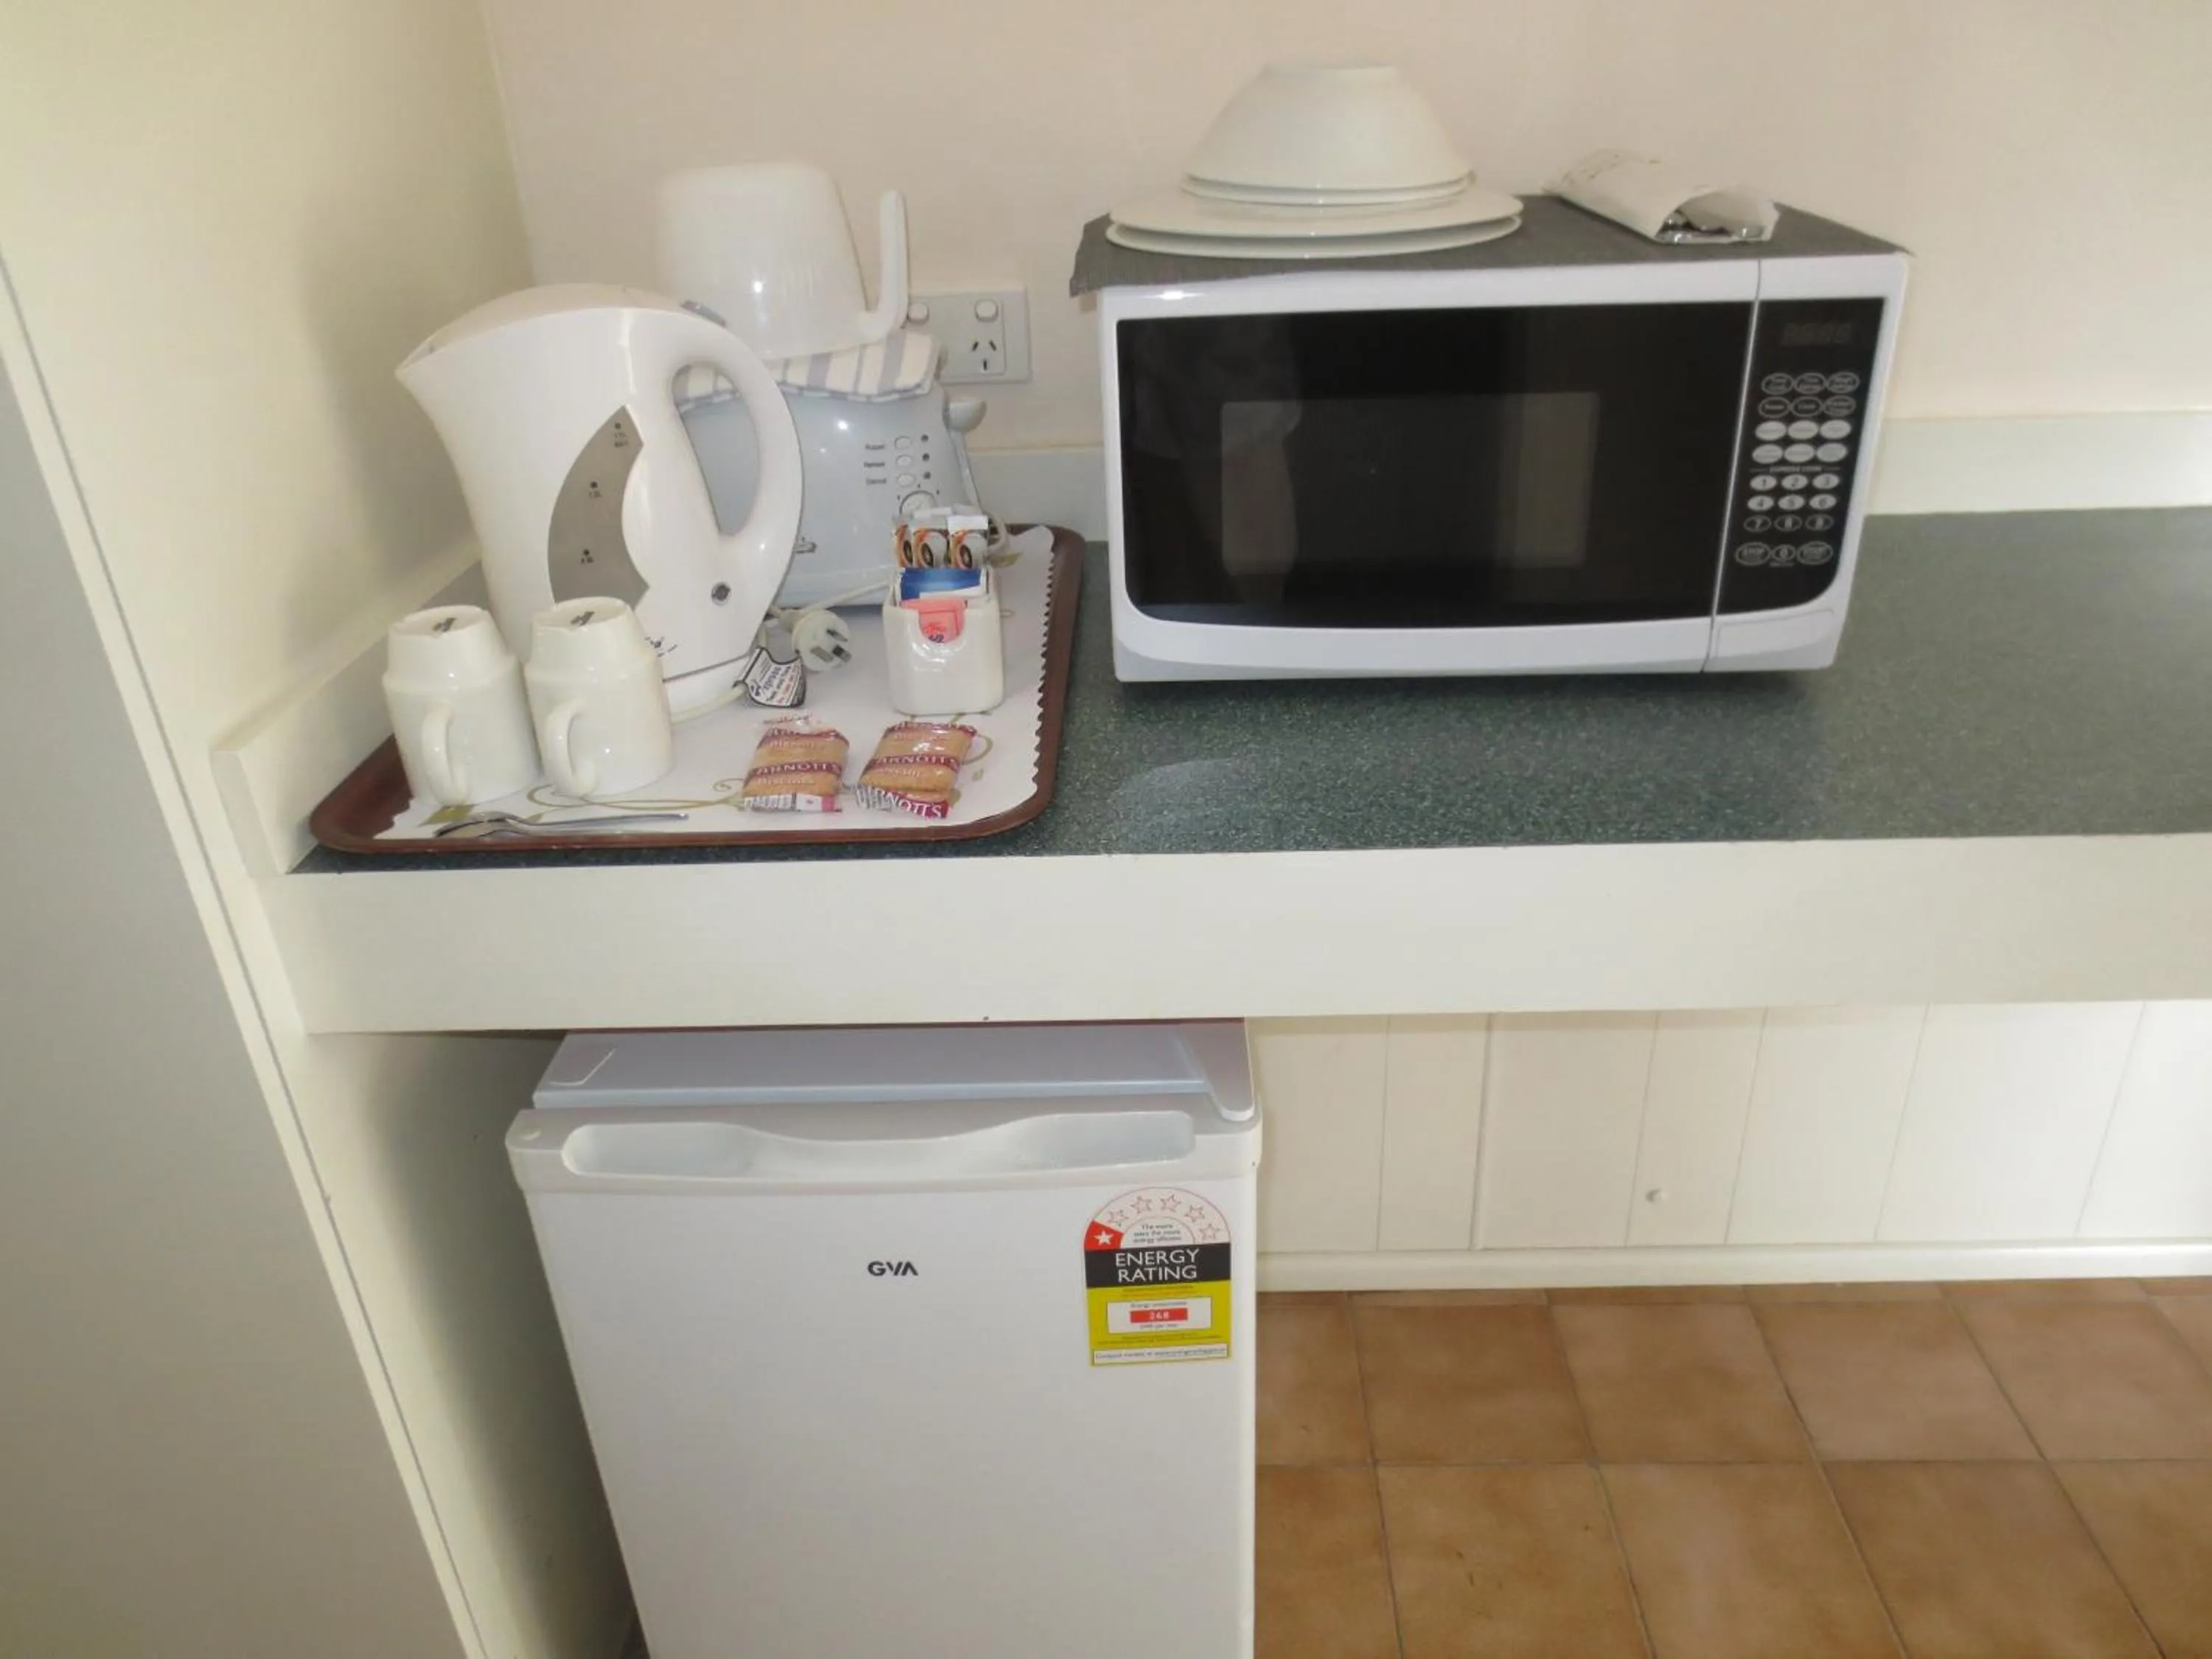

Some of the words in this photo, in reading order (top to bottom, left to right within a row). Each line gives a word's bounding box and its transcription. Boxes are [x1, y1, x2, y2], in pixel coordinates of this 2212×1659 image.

[1115, 1248, 1200, 1267] ENERGY
[868, 1260, 919, 1276] GVA
[1118, 1265, 1197, 1284] RATING
